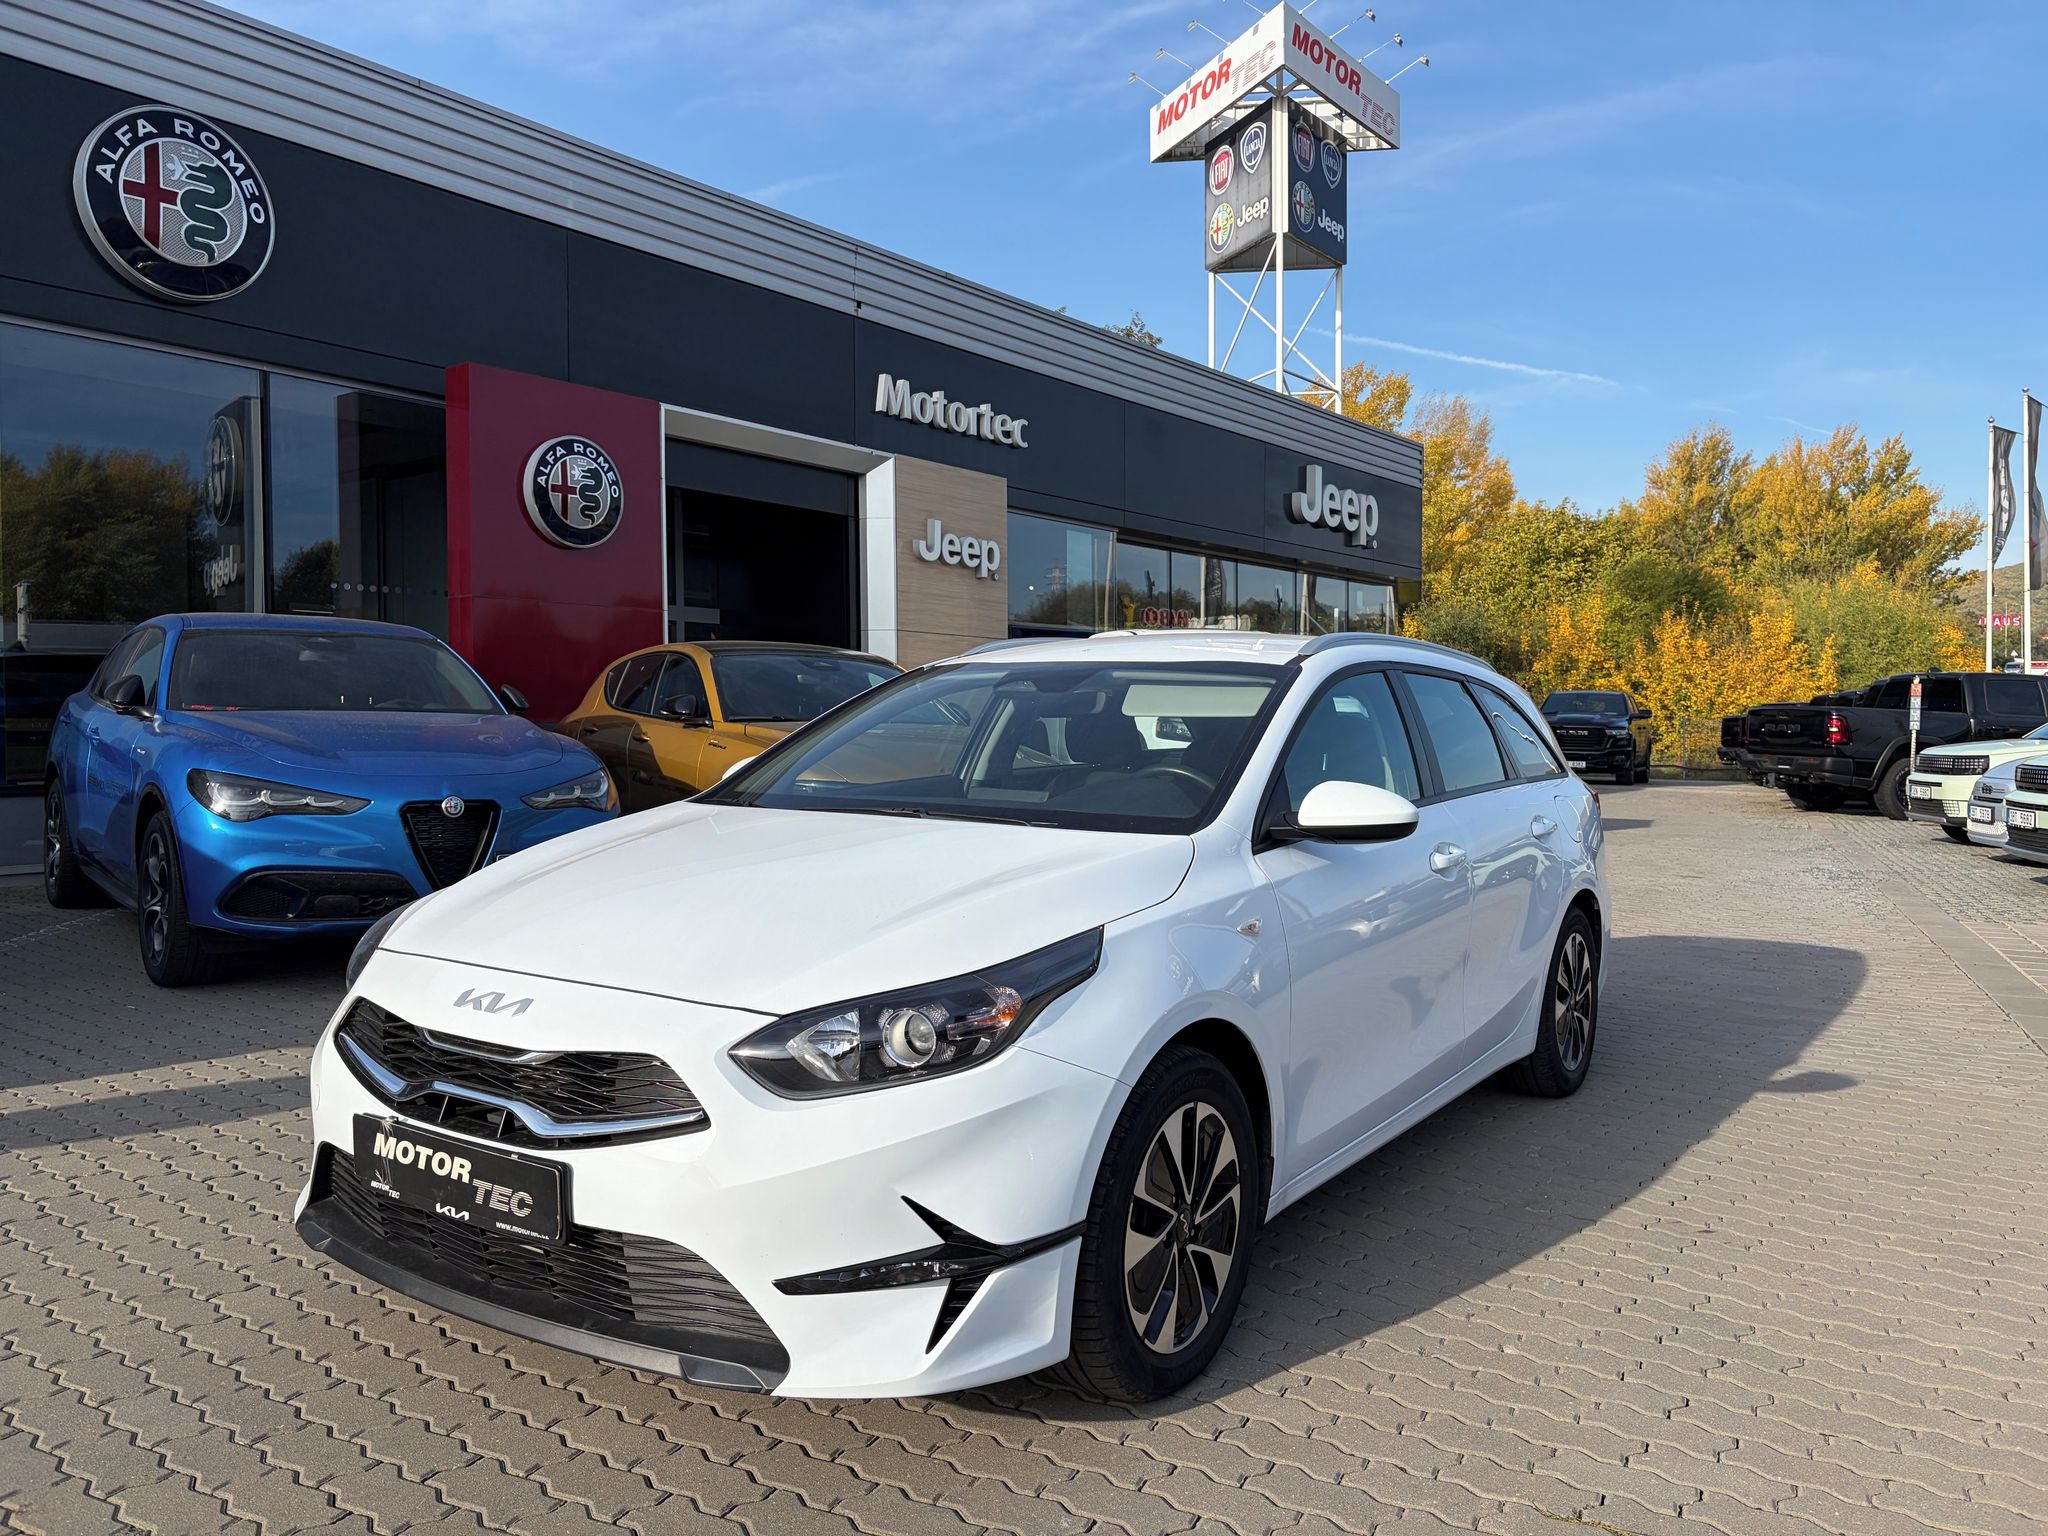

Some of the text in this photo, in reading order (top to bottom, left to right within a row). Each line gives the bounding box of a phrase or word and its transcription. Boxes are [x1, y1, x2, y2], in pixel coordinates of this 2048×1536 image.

[1158, 40, 1277, 135] MOTOR TEC
[1291, 22, 1396, 137] MOTOR TEC
[95, 117, 266, 225] ALFA ROMEO
[1215, 157, 1229, 183] FIAT
[1245, 137, 1261, 156] LANCIA
[1298, 133, 1311, 161] FIAT
[1236, 196, 1269, 228] Jeep
[1317, 209, 1344, 243] Jeep
[874, 372, 1030, 450] Motortec
[536, 442, 620, 498] ALFA ROMEO
[1291, 463, 1379, 548] Jeep
[913, 518, 1000, 579] Jeep
[453, 987, 535, 1017] KIA
[370, 1179, 401, 1200] MOTOR TEC
[373, 1132, 534, 1218] MOTOR TEC
